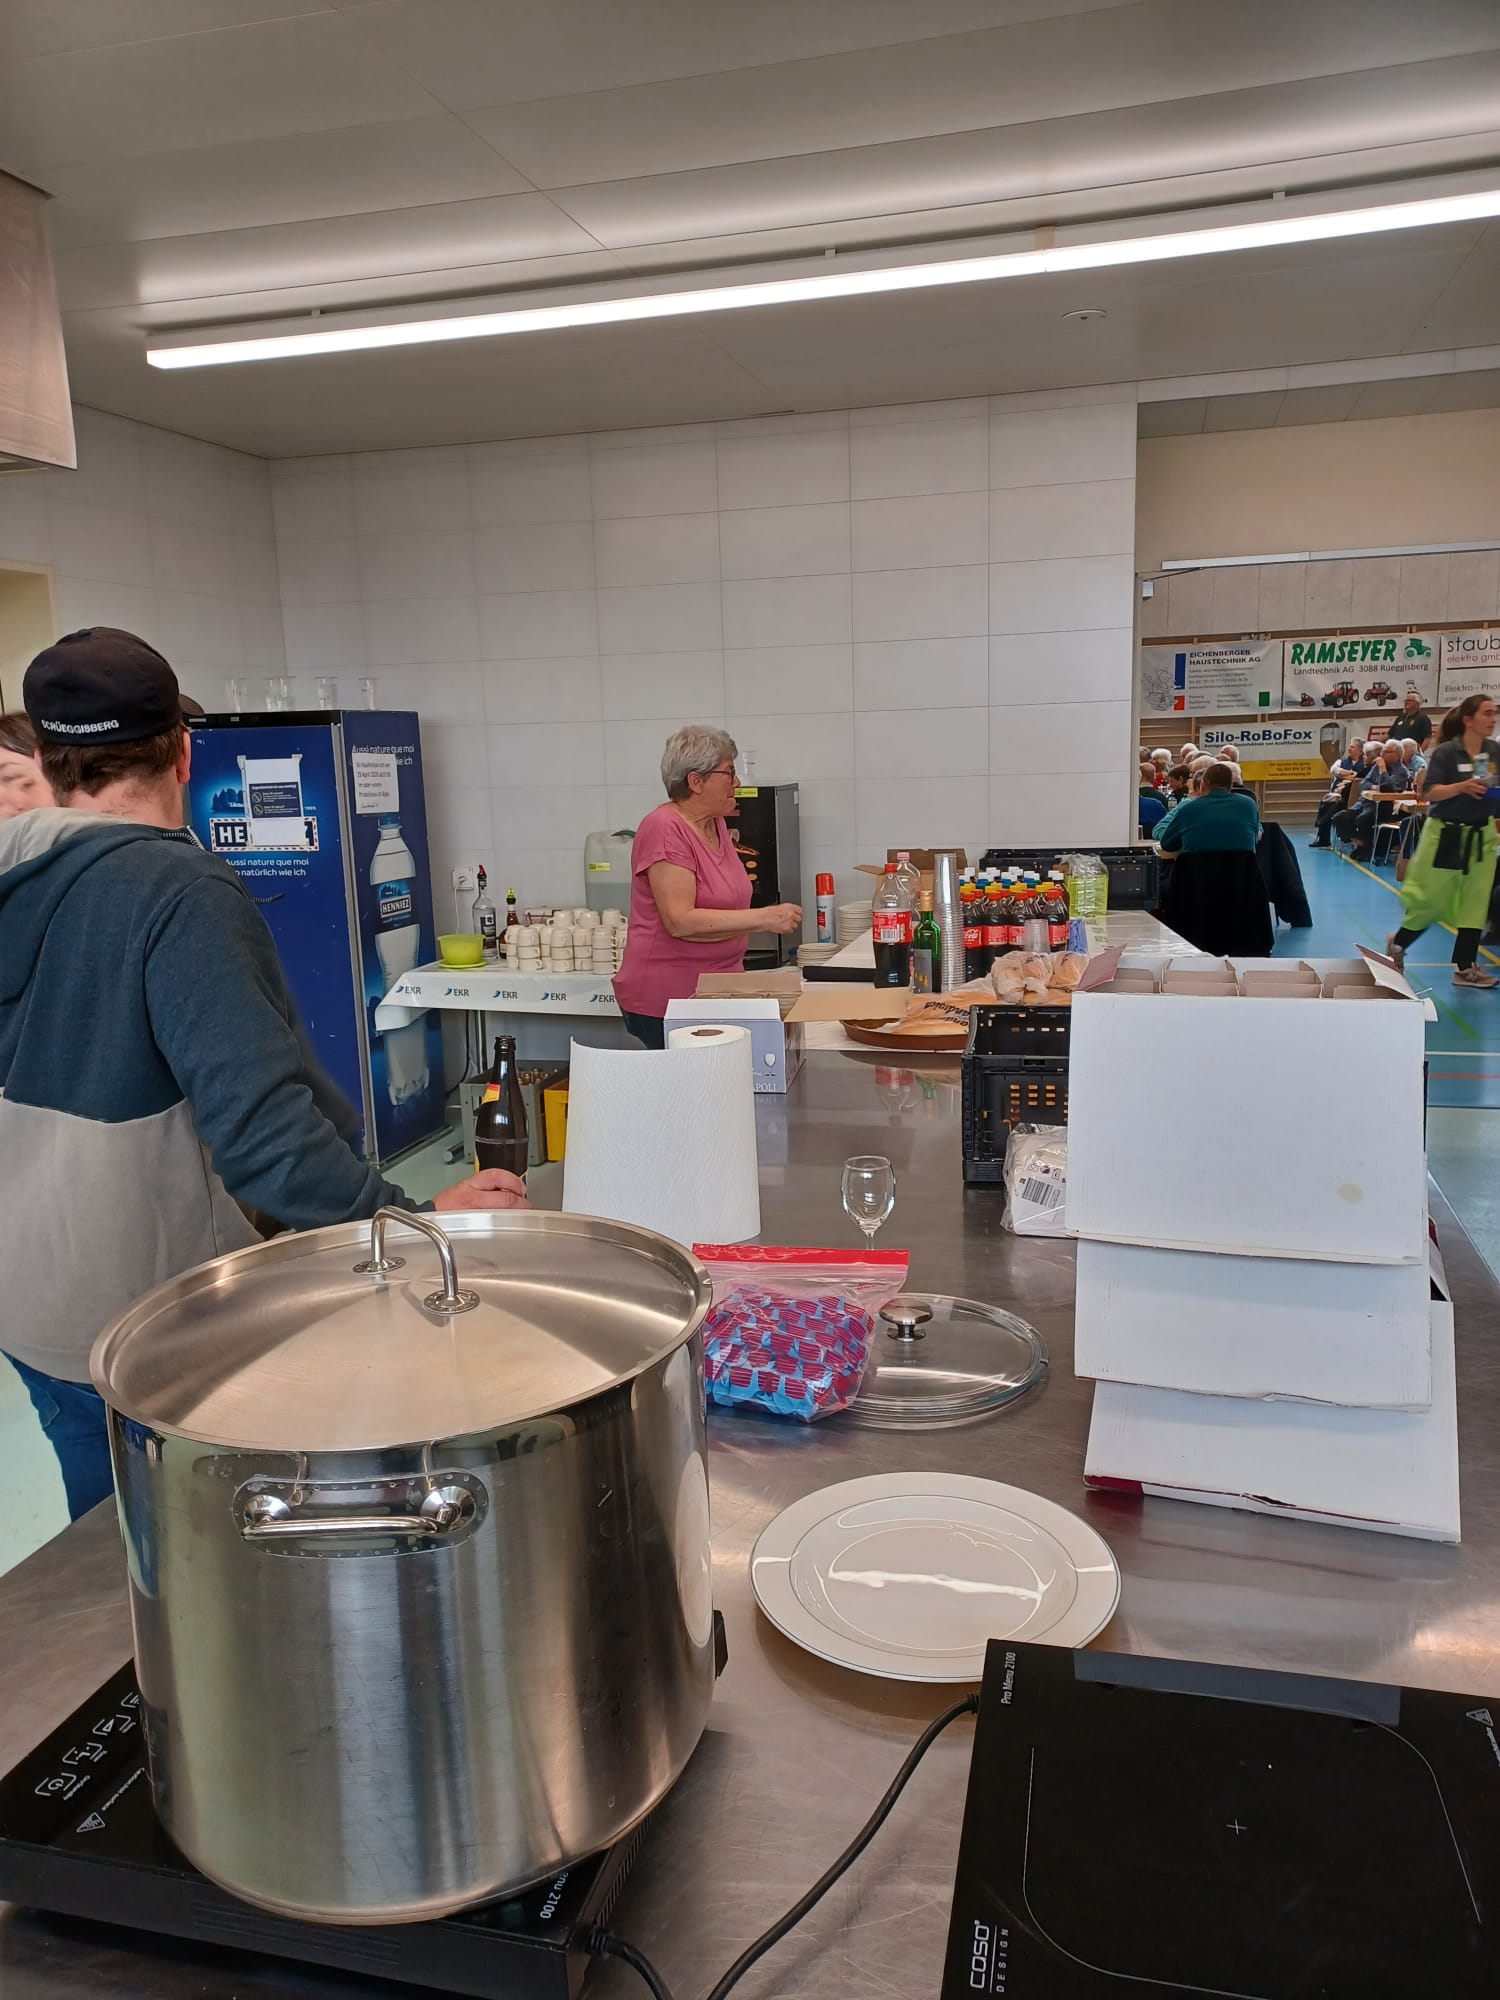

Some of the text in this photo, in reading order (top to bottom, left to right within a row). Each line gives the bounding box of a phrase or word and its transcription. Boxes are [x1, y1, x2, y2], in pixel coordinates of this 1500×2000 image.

[1190, 649, 1251, 659] EICHENBERGER
[1291, 639, 1397, 666] RAMSEYER
[1189, 657, 1247, 666] HAUSTECHNIK
[1293, 663, 1429, 676] Landtechnik AG 3088 Rüeggisberg
[1445, 684, 1473, 693] Elektro
[1204, 728, 1312, 744] Silo-RoBoFox
[352, 744, 415, 755] Aussi nature que moi
[276, 859, 292, 868] que
[293, 857, 309, 866] moi
[241, 868, 278, 877] natürlich
[279, 868, 293, 877] wie
[293, 868, 306, 876] ich
[382, 898, 409, 914] HENNIEZ
[405, 986, 421, 995] EKR
[454, 988, 469, 997] EKR
[502, 990, 518, 999] EKR
[550, 992, 567, 1001] EKR
[599, 994, 615, 1003] EKR
[1000, 1651, 1016, 1705] Pro Menu 2100
[539, 1872, 569, 1919] enu 2100
[996, 1928, 1009, 1993] DESIGN
